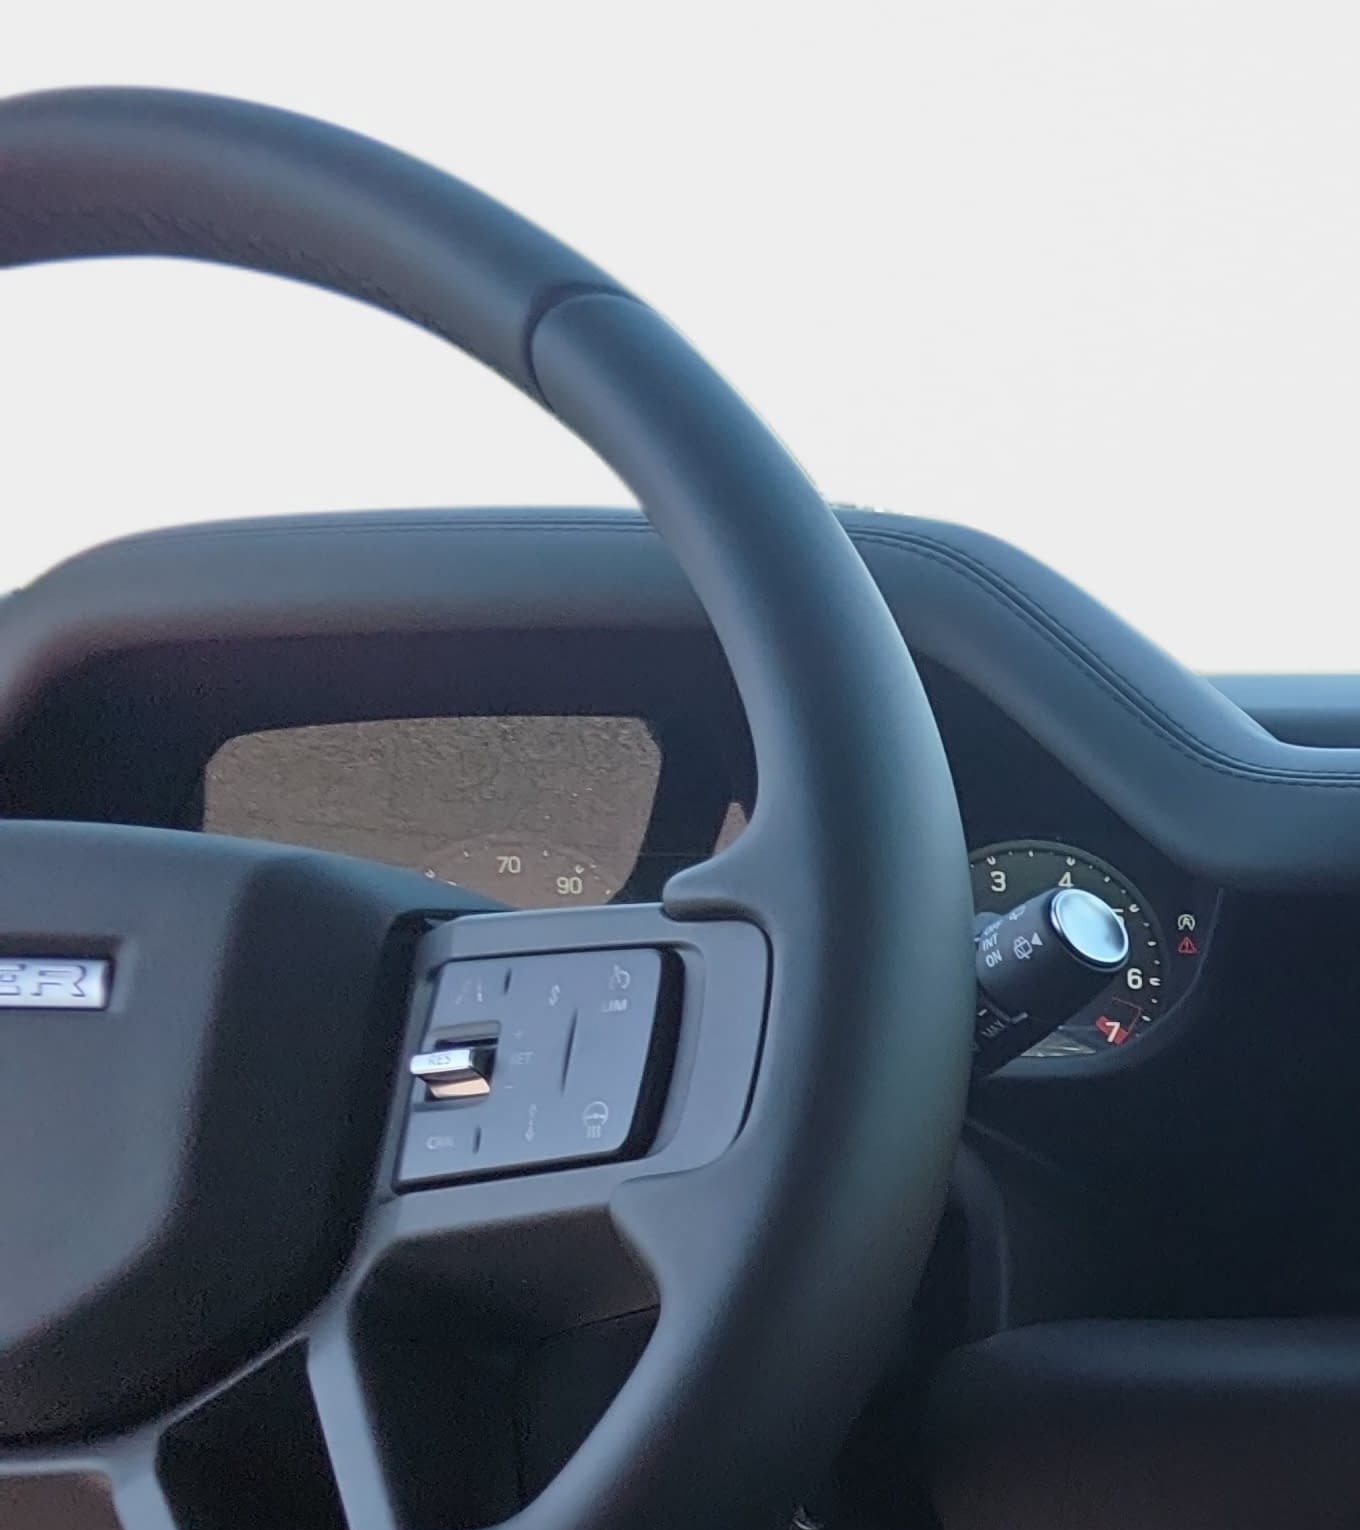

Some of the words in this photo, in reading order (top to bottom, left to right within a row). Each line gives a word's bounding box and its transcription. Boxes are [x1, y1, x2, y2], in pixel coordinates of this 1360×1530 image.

[496, 856, 521, 874] 70
[556, 876, 583, 895] 90
[990, 871, 1007, 892] 3
[1058, 871, 1074, 888] 4
[985, 949, 1003, 968] ON
[1126, 968, 1143, 990] 6
[1105, 1021, 1121, 1043] 7
